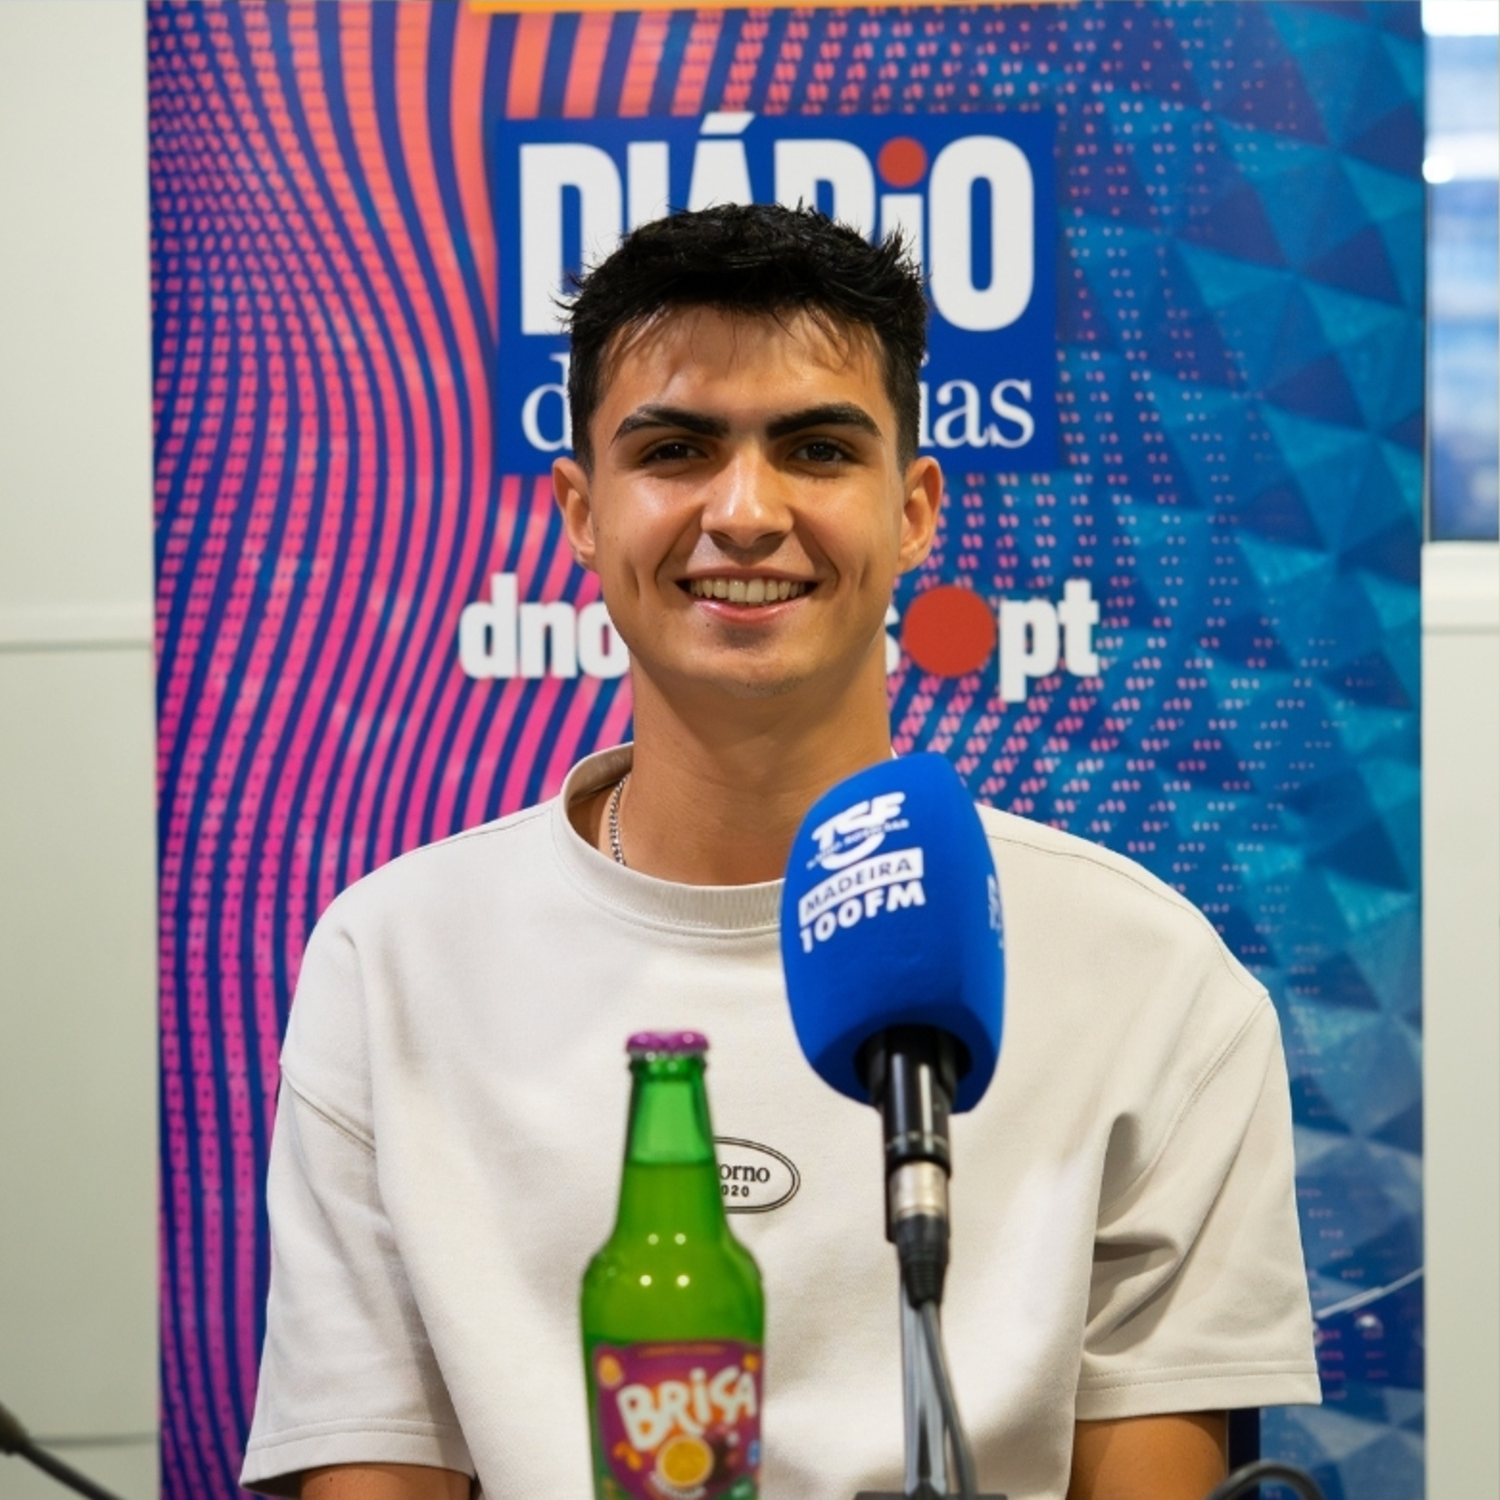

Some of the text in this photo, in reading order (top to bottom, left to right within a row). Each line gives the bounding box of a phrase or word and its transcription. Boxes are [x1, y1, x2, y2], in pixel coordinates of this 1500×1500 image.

[804, 857, 912, 918] MADEIRA
[800, 880, 926, 953] 100FM
[719, 1163, 770, 1184] orno
[720, 1184, 750, 1198] 020
